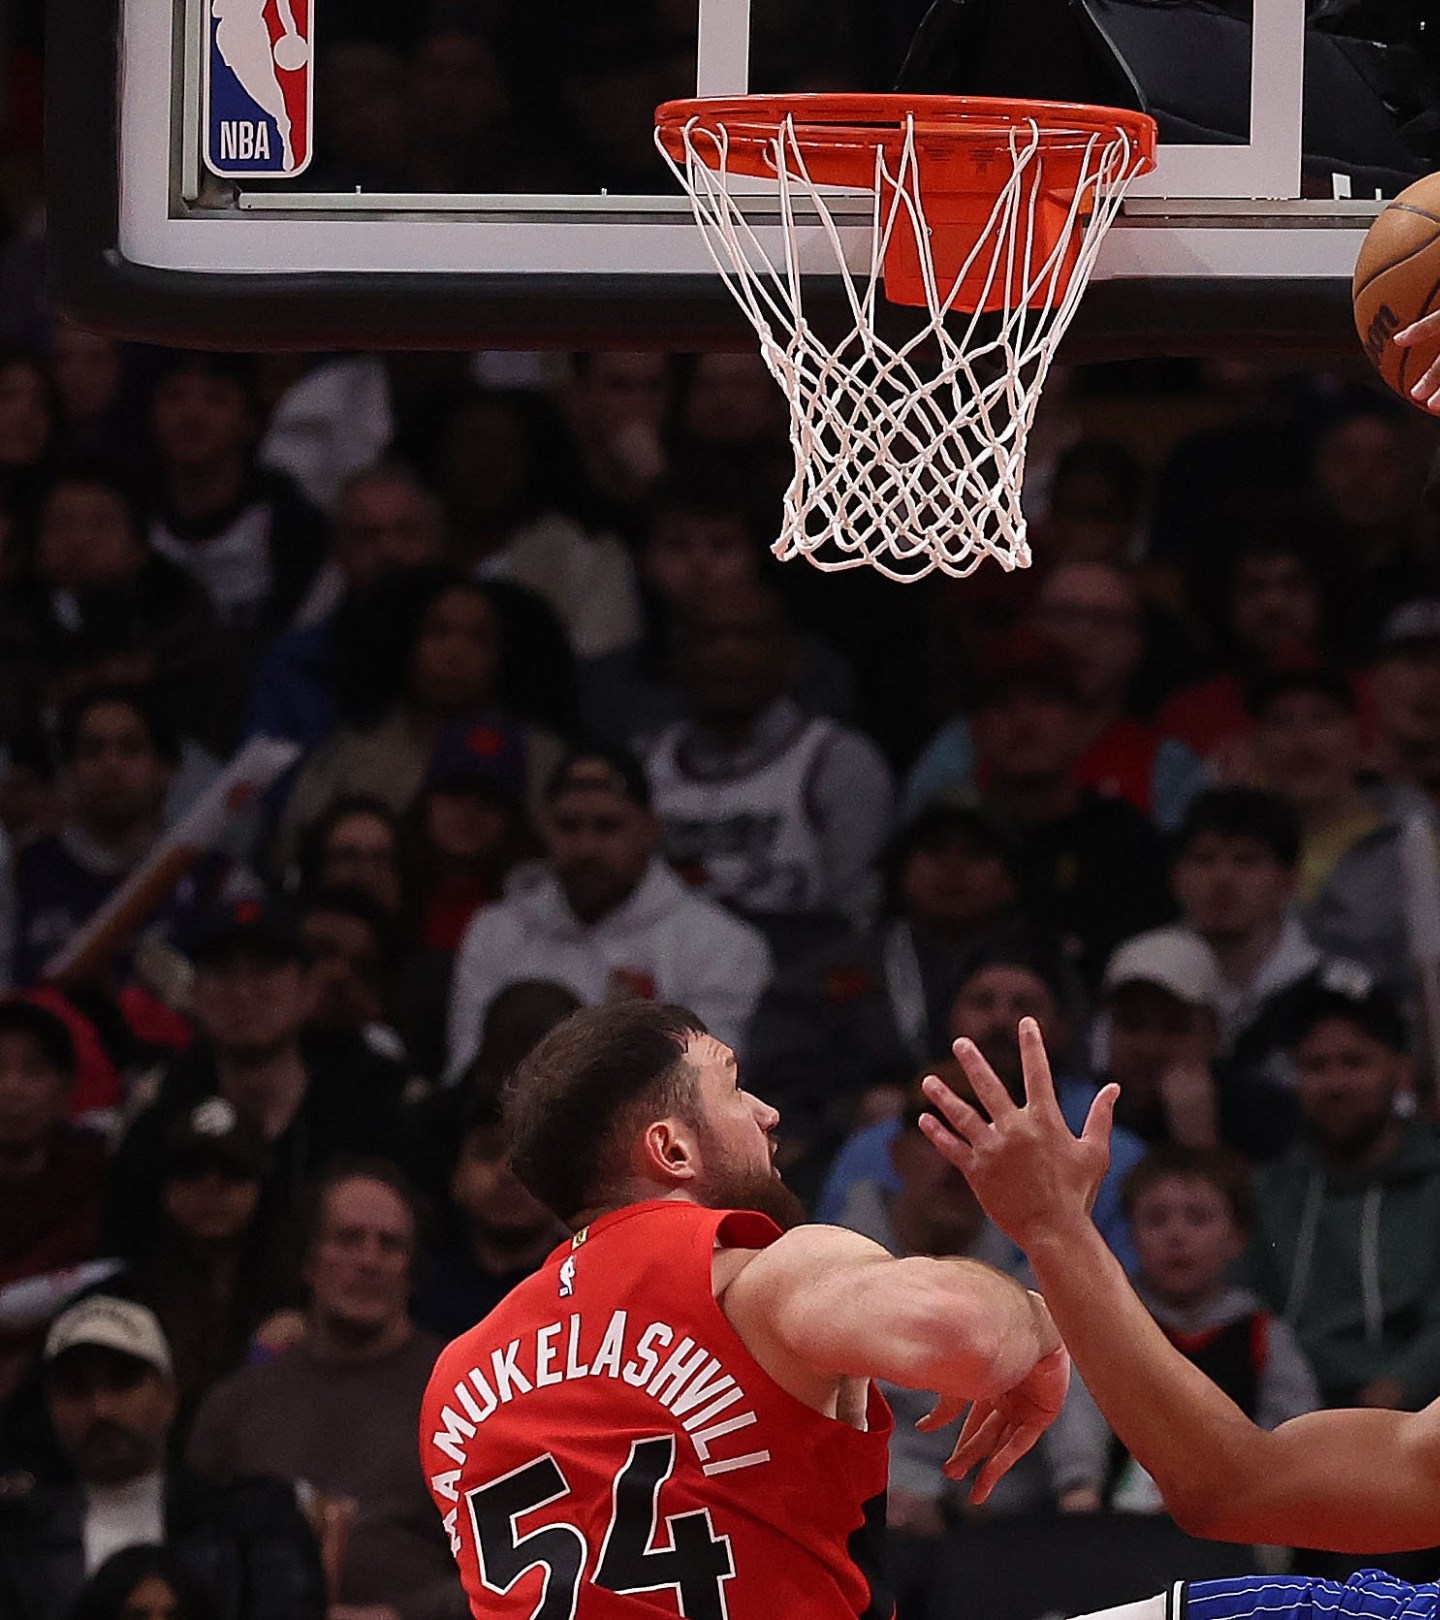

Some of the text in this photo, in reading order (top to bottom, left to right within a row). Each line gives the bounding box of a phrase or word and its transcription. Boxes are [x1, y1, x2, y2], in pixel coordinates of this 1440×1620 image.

[220, 120, 270, 160] NBA
[431, 1309, 770, 1558] MAMUKELASHVILI
[464, 1433, 737, 1620] 54
